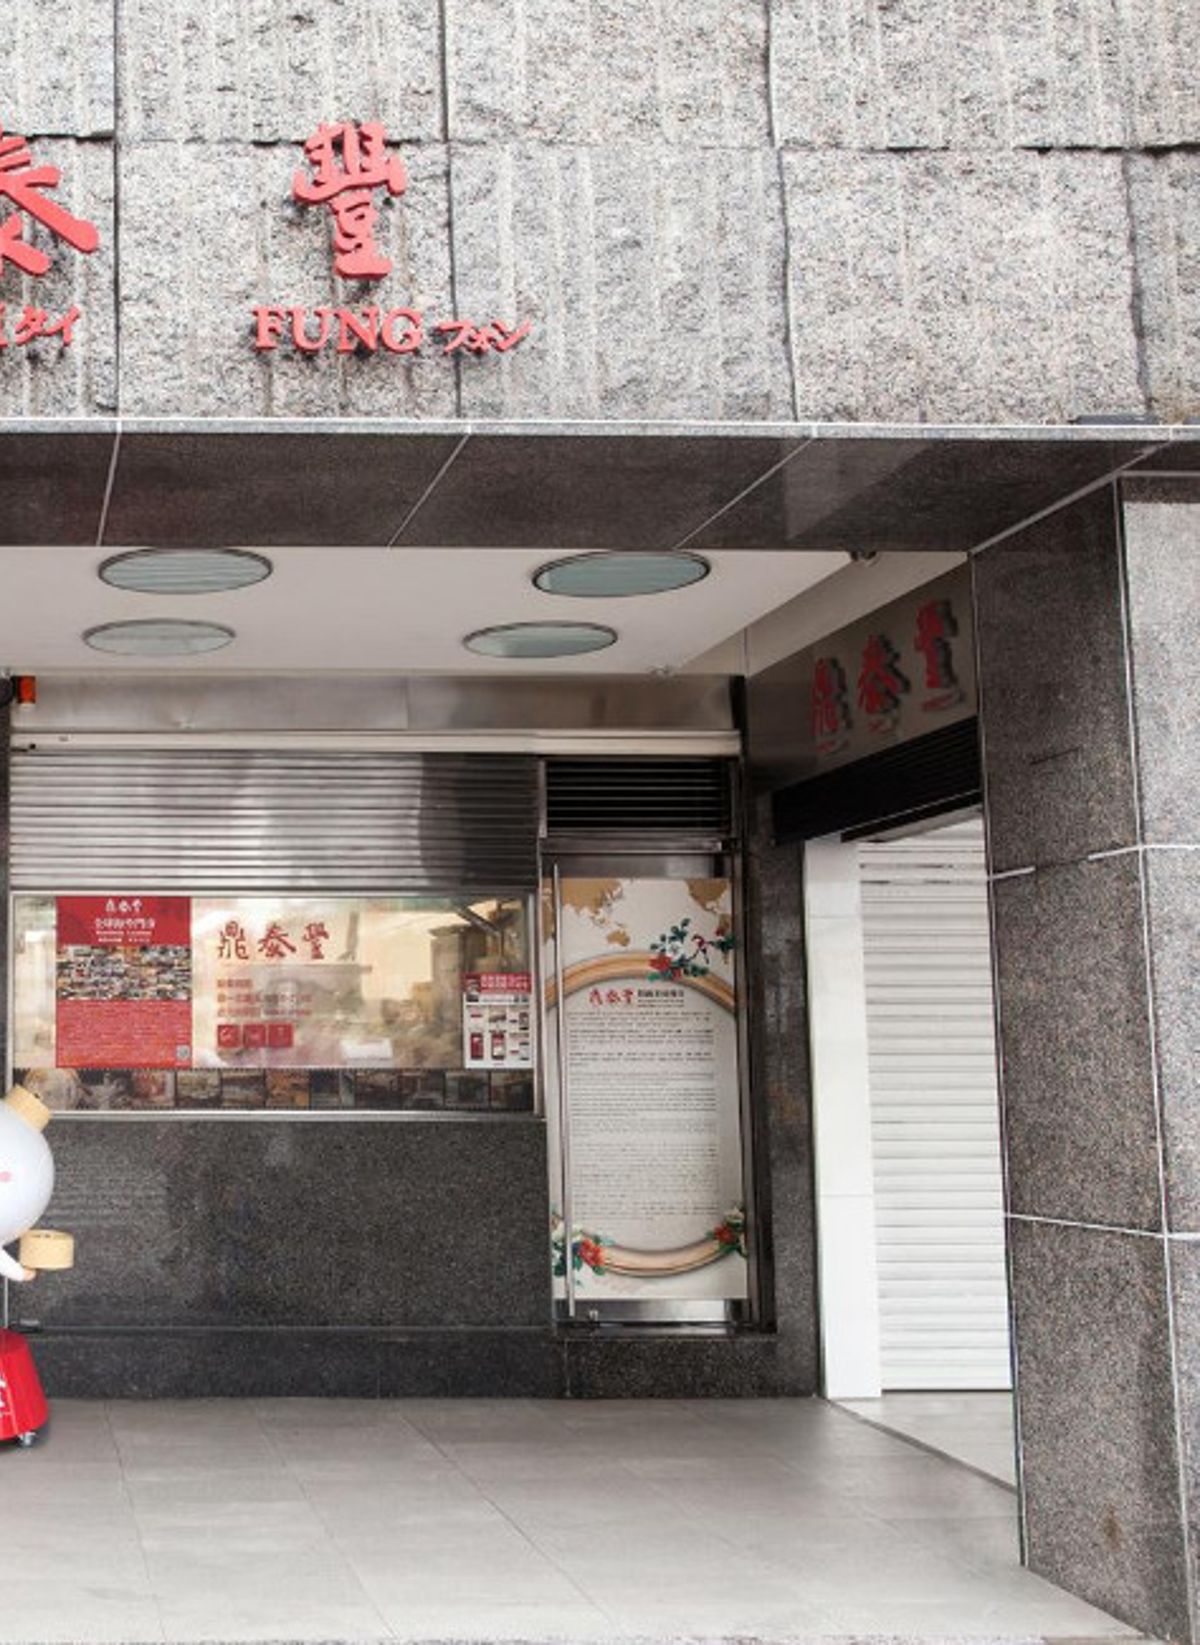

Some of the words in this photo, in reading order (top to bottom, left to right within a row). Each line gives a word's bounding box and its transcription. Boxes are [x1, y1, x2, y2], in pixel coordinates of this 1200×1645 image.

[14, 305, 81, 348] タイ
[252, 307, 425, 353] FUNG
[217, 920, 331, 960] 鼎泰豐
